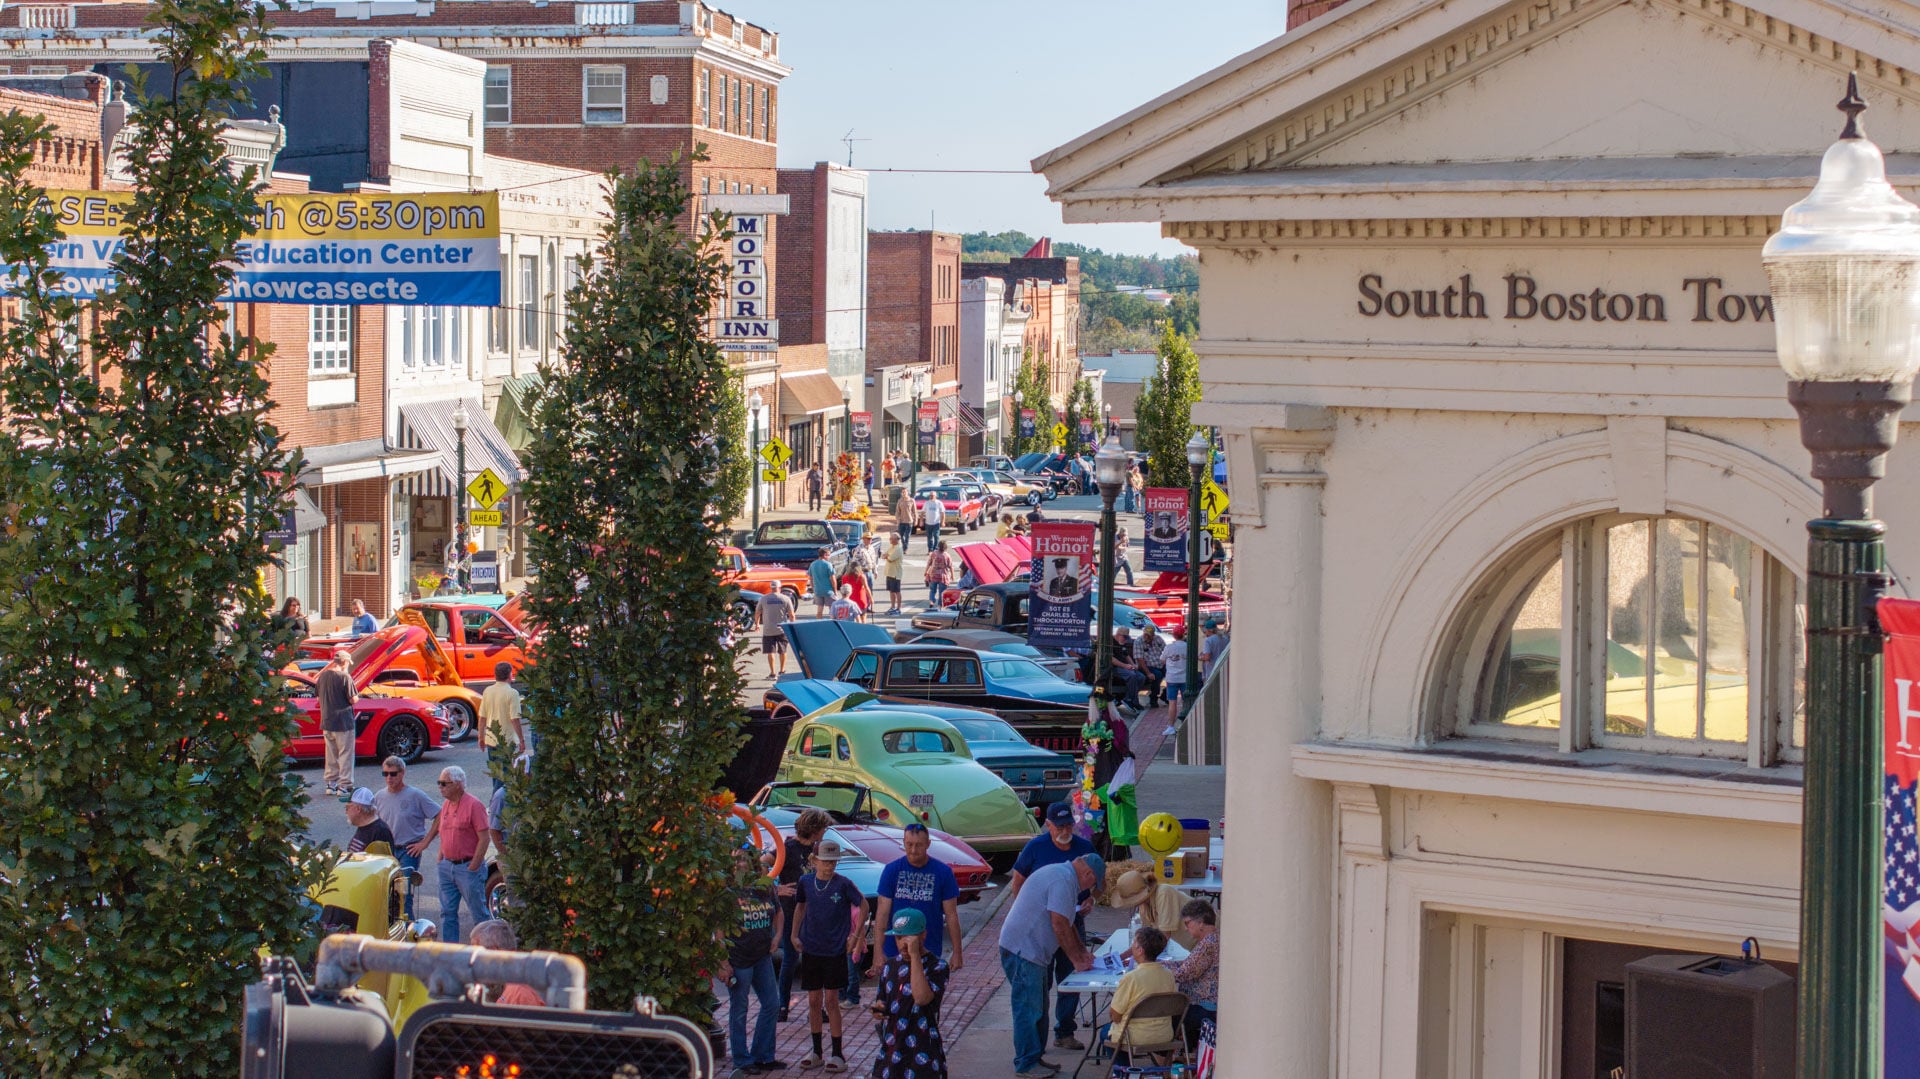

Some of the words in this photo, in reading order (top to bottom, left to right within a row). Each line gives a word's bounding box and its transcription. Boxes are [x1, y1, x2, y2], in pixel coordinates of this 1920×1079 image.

[298, 201, 485, 236] @5:30pm
[236, 243, 372, 265] Education
[381, 244, 473, 264] Center
[737, 218, 757, 317] MOTOR
[1357, 274, 1489, 319] South
[1503, 275, 1668, 322] Boston
[723, 322, 768, 337] INN
[1148, 498, 1185, 509] Honor
[474, 514, 498, 523] AHEAD
[1036, 538, 1090, 553] Honor
[1063, 536, 1088, 544] proudly
[837, 607, 850, 619] 21
[898, 870, 936, 881] SWING
